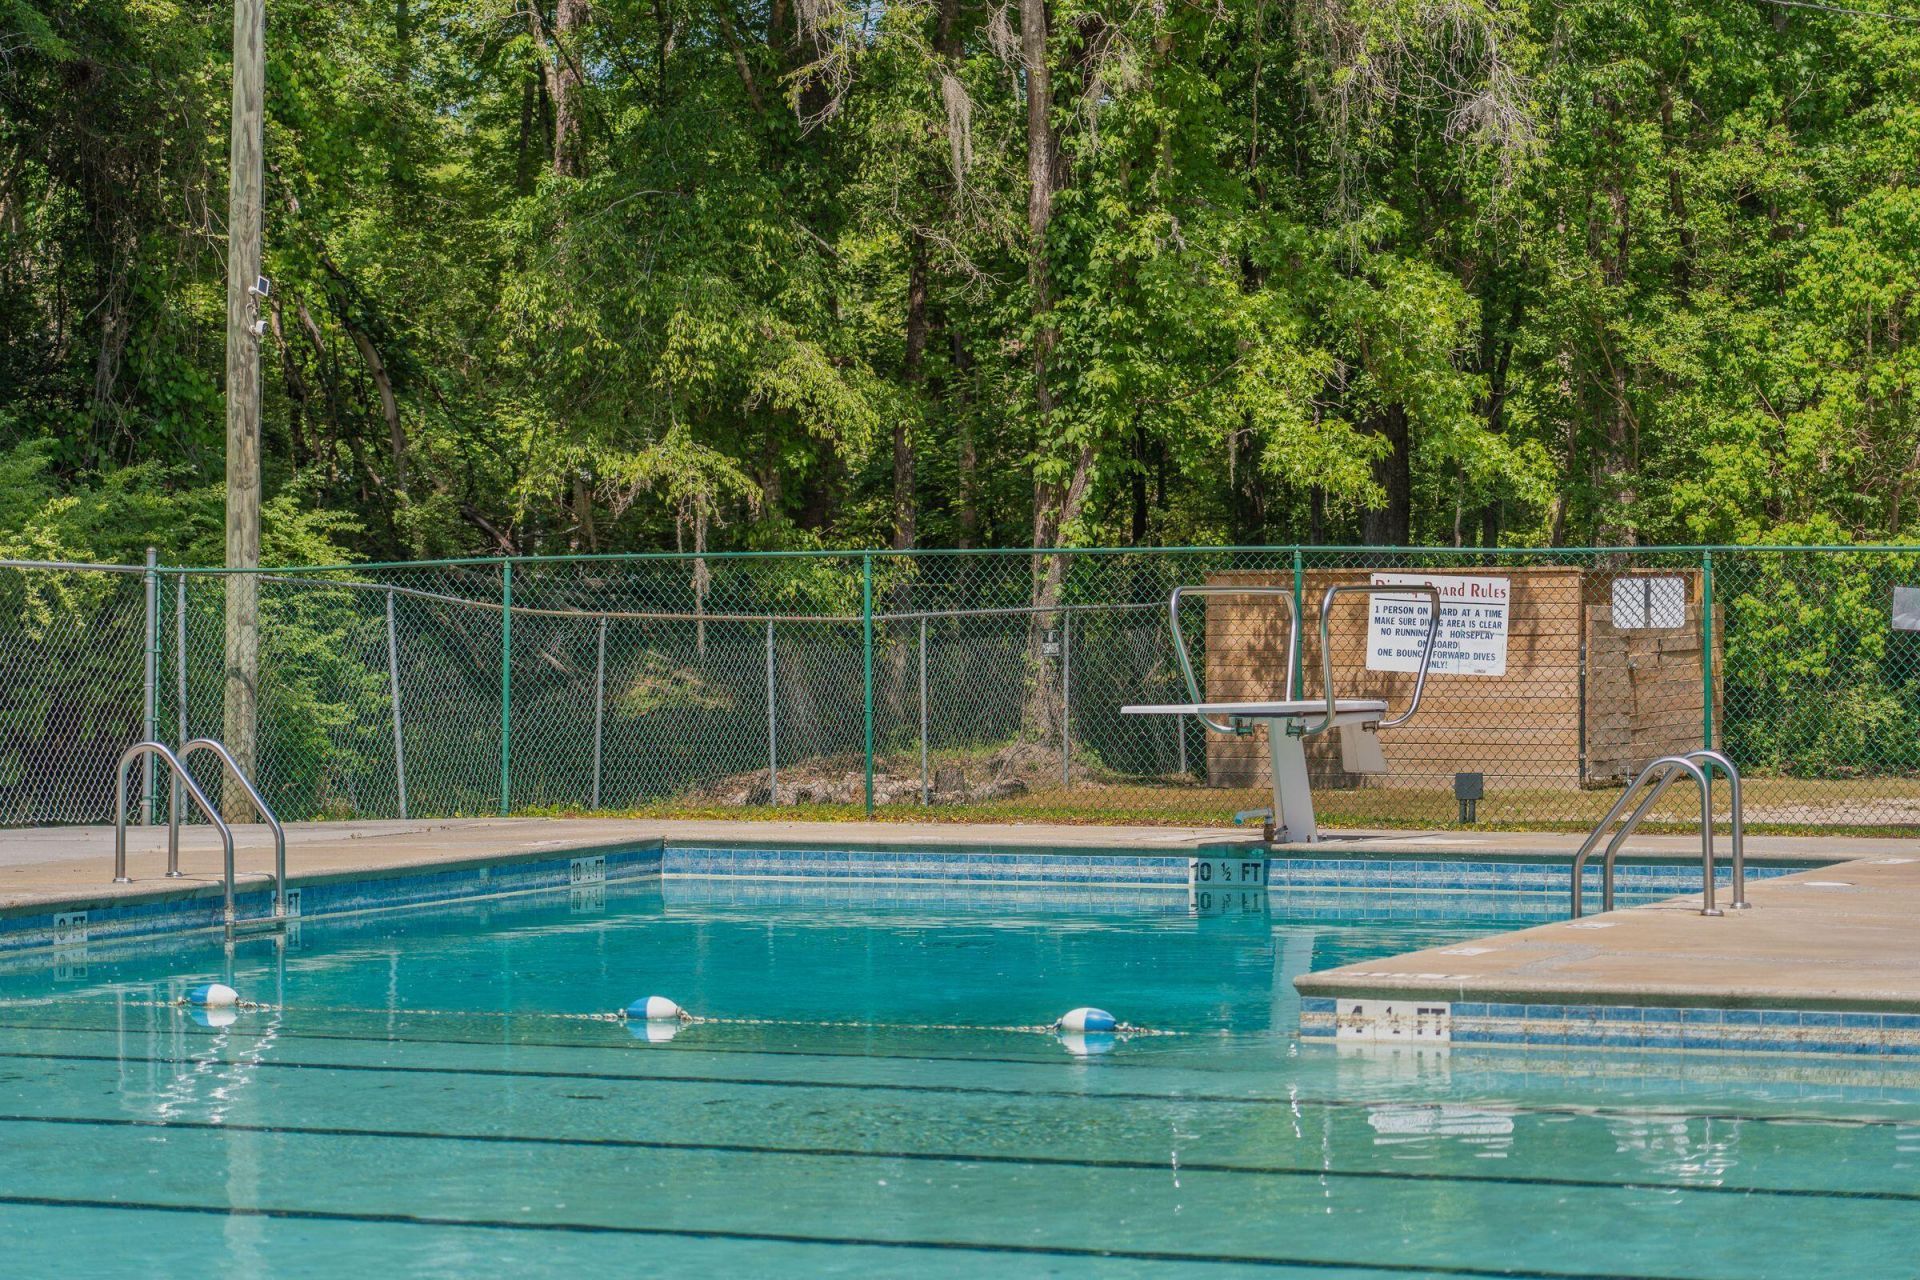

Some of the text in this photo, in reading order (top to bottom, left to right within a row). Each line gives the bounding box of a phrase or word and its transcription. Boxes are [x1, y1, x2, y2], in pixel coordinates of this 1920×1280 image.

[1375, 605, 1379, 613] 1
[1383, 605, 1414, 614] PERSON
[1417, 607, 1428, 615] ON
[1461, 608, 1471, 617] AT
[1475, 609, 1481, 617] A
[1484, 609, 1503, 618] TIME
[1374, 616, 1503, 629] MAKE SURE DIVG AREA IS CLEAR
[1380, 627, 1392, 636] NO
[1395, 628, 1429, 637] RUNNING
[1449, 629, 1495, 640] HORSEPLAY
[1377, 648, 1496, 661] ONE BOUNC FORWARD DIVES
[1190, 862, 1212, 881] 10
[1241, 862, 1261, 881] FT
[288, 892, 300, 914] FT
[1417, 1007, 1446, 1036] FT
